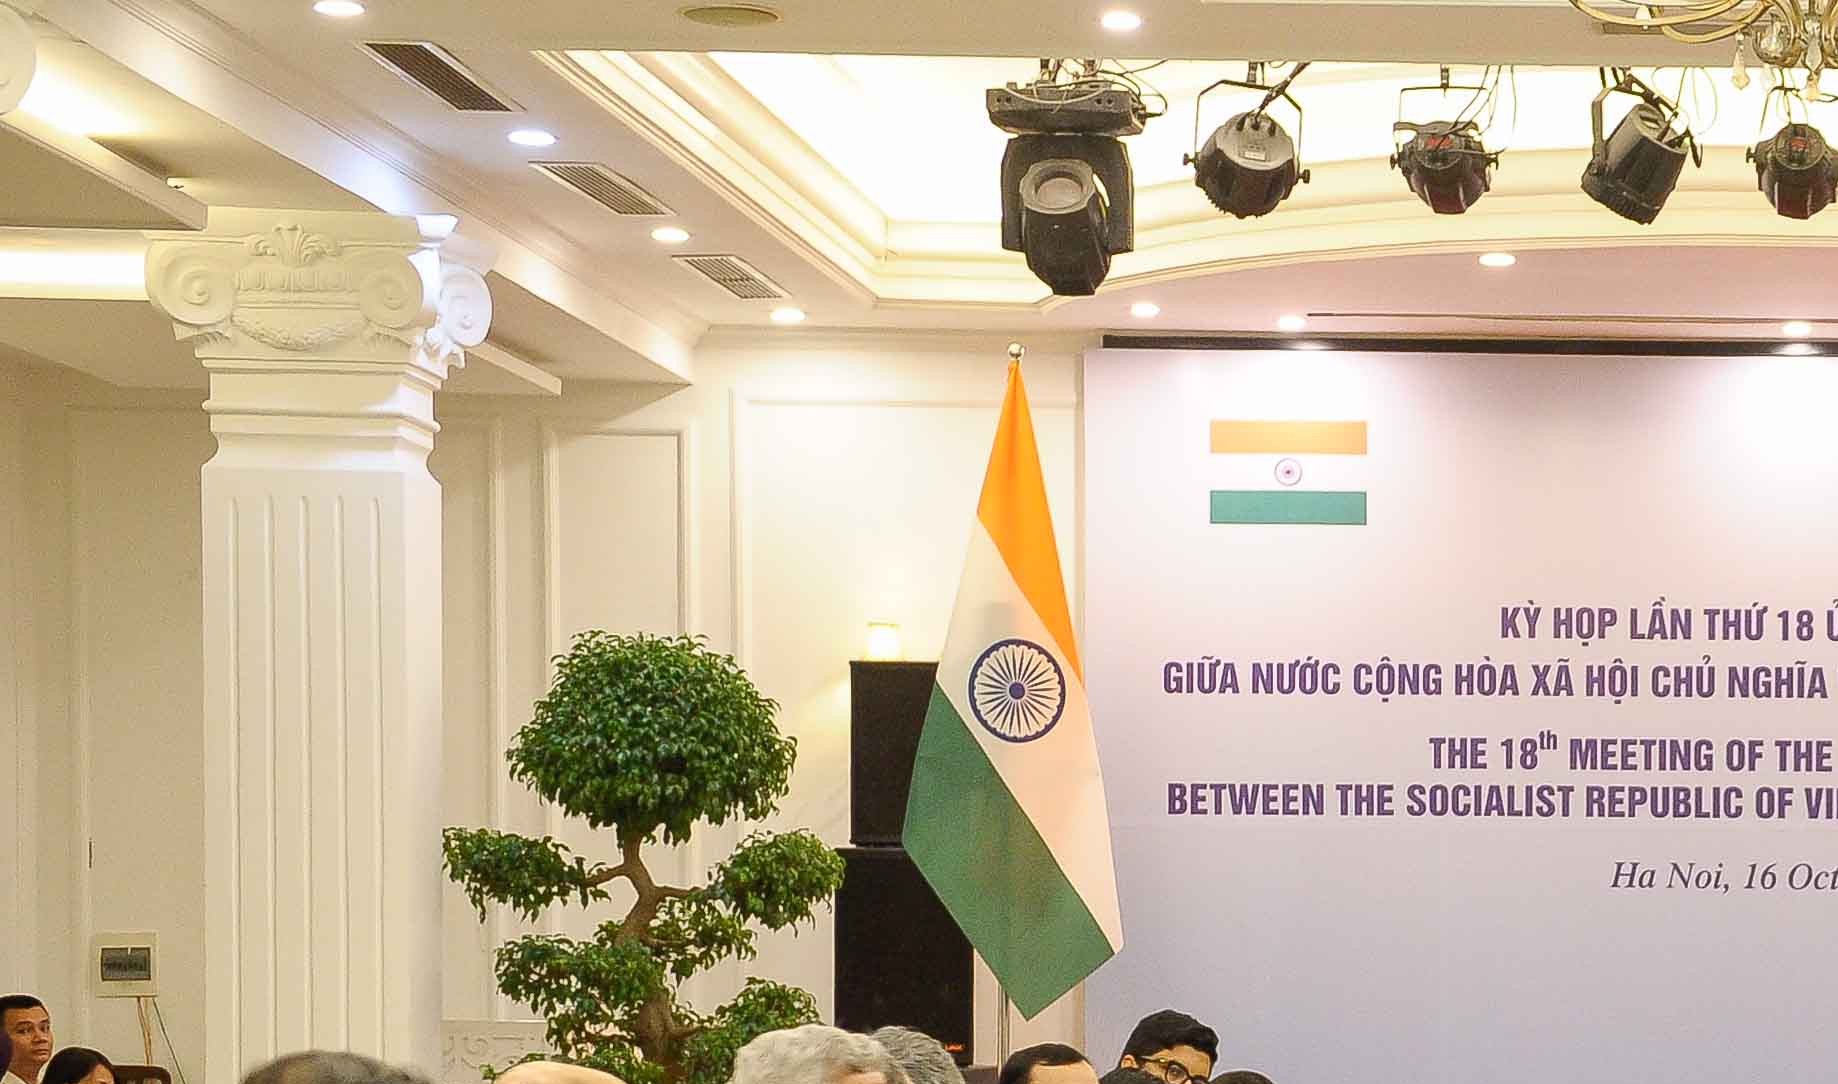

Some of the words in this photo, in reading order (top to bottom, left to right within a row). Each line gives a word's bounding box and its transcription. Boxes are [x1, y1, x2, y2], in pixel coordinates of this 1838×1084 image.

[1500, 599, 1542, 641] KỲ
[1552, 607, 1617, 648] HỌP
[1629, 596, 1692, 641] LẦN
[1703, 601, 1768, 642] THỨ
[1776, 609, 1814, 642] 18
[1162, 655, 1240, 696] GIỮA
[1251, 655, 1341, 697] NƯỚC
[1352, 656, 1443, 703] CỘNG
[1453, 657, 1520, 698] HÒA
[1530, 655, 1576, 698] XÃ
[1584, 657, 1639, 705] HỘI
[1649, 654, 1719, 699] CHỦ
[1726, 659, 1829, 701] NGHĨA
[1428, 736, 1489, 770] THE
[1567, 737, 1715, 773] MEETING
[1725, 739, 1765, 773] OF
[1774, 739, 1834, 774] THE
[1166, 781, 1325, 817] BETWEEN
[1335, 782, 1395, 817] THE
[1405, 783, 1575, 819] SOCIALIST
[1584, 784, 1745, 820] REPUBLIC
[1754, 785, 1795, 821] OF
[1609, 860, 1657, 891] Ha
[1666, 860, 1731, 894] Noi,
[1741, 862, 1777, 892] 16
